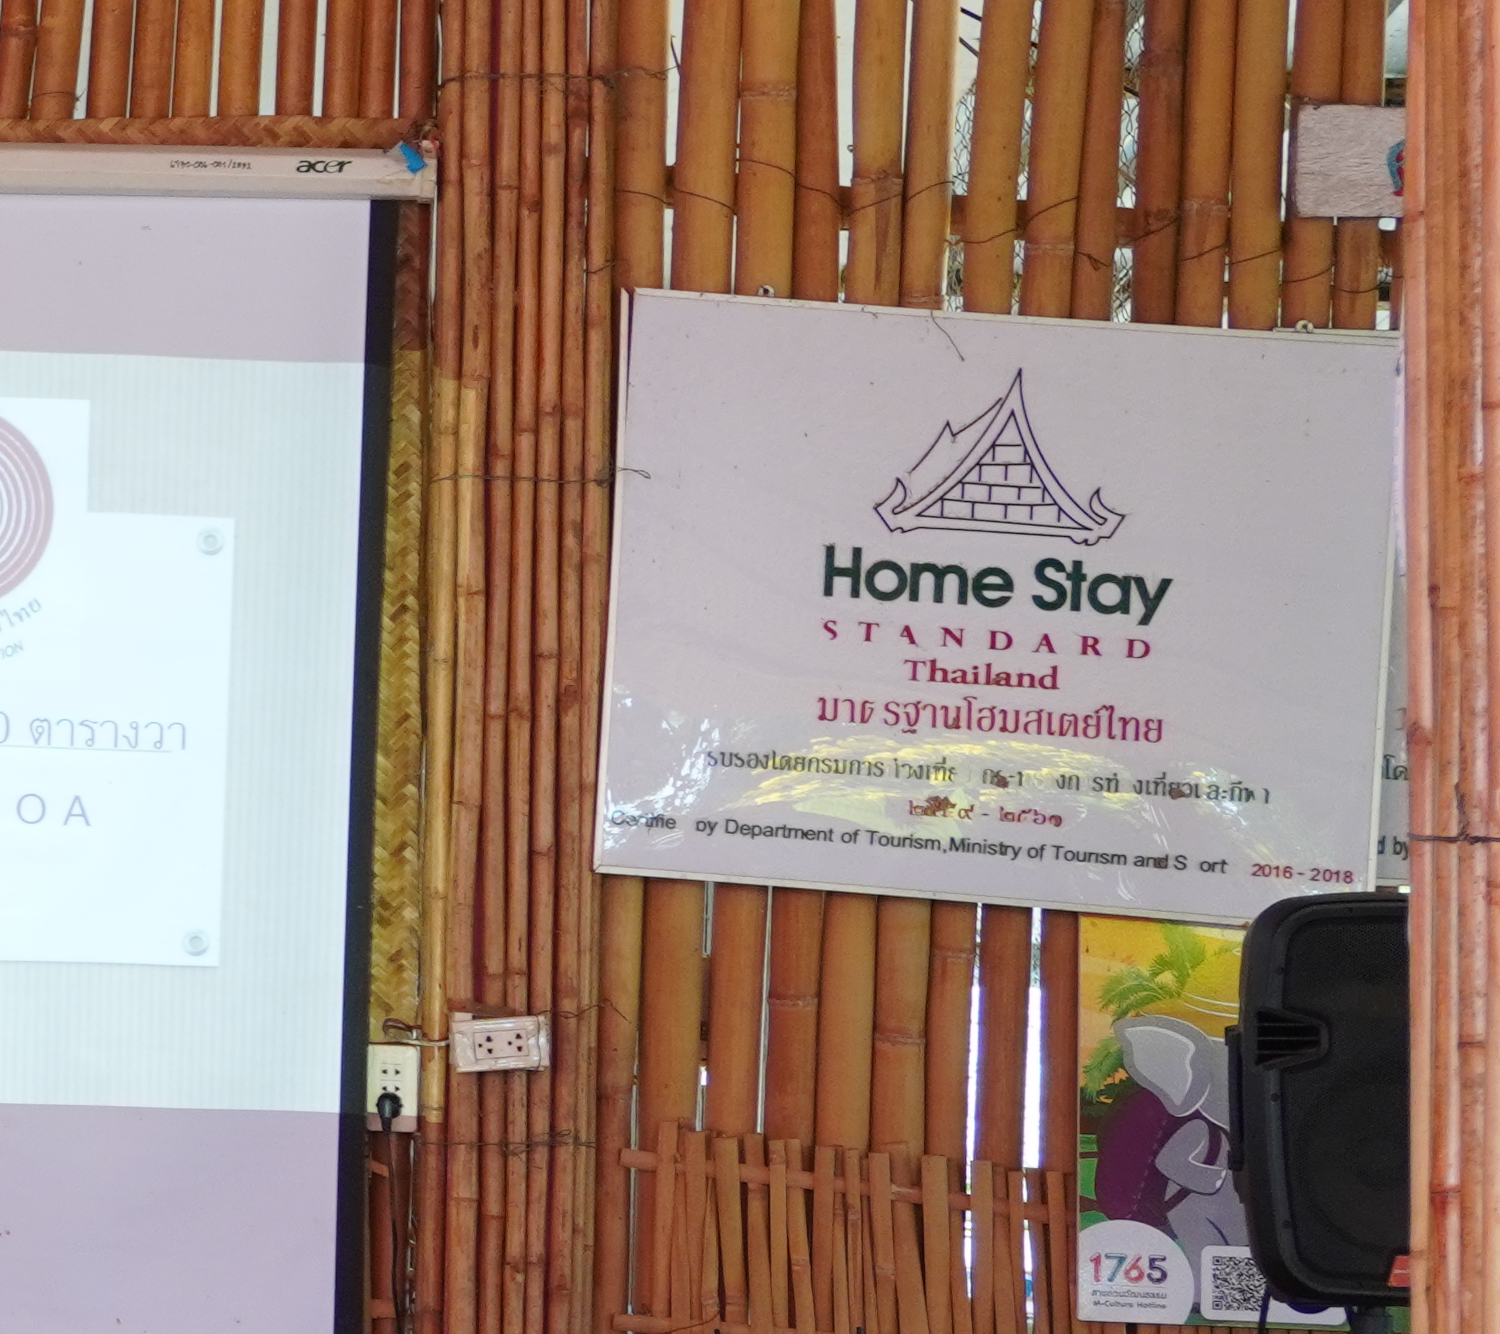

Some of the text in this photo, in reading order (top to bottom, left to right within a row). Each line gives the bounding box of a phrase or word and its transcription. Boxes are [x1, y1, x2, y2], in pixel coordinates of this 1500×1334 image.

[295, 158, 353, 174] acer
[822, 543, 1174, 626] Home Stay
[822, 620, 1152, 660] STANDARD
[904, 659, 1060, 691] Thailand
[28, 715, 188, 753] ตารางวา
[725, 818, 835, 843] Department
[840, 827, 862, 845] of
[949, 836, 1023, 861] Ministry
[1026, 842, 1047, 861] of
[1051, 844, 1128, 867] Tourism
[1133, 852, 1170, 869] and
[1173, 855, 1229, 875] Sort
[1251, 863, 1293, 880] 2016
[1309, 867, 1354, 884] 2018
[1089, 1252, 1168, 1285] 1765
